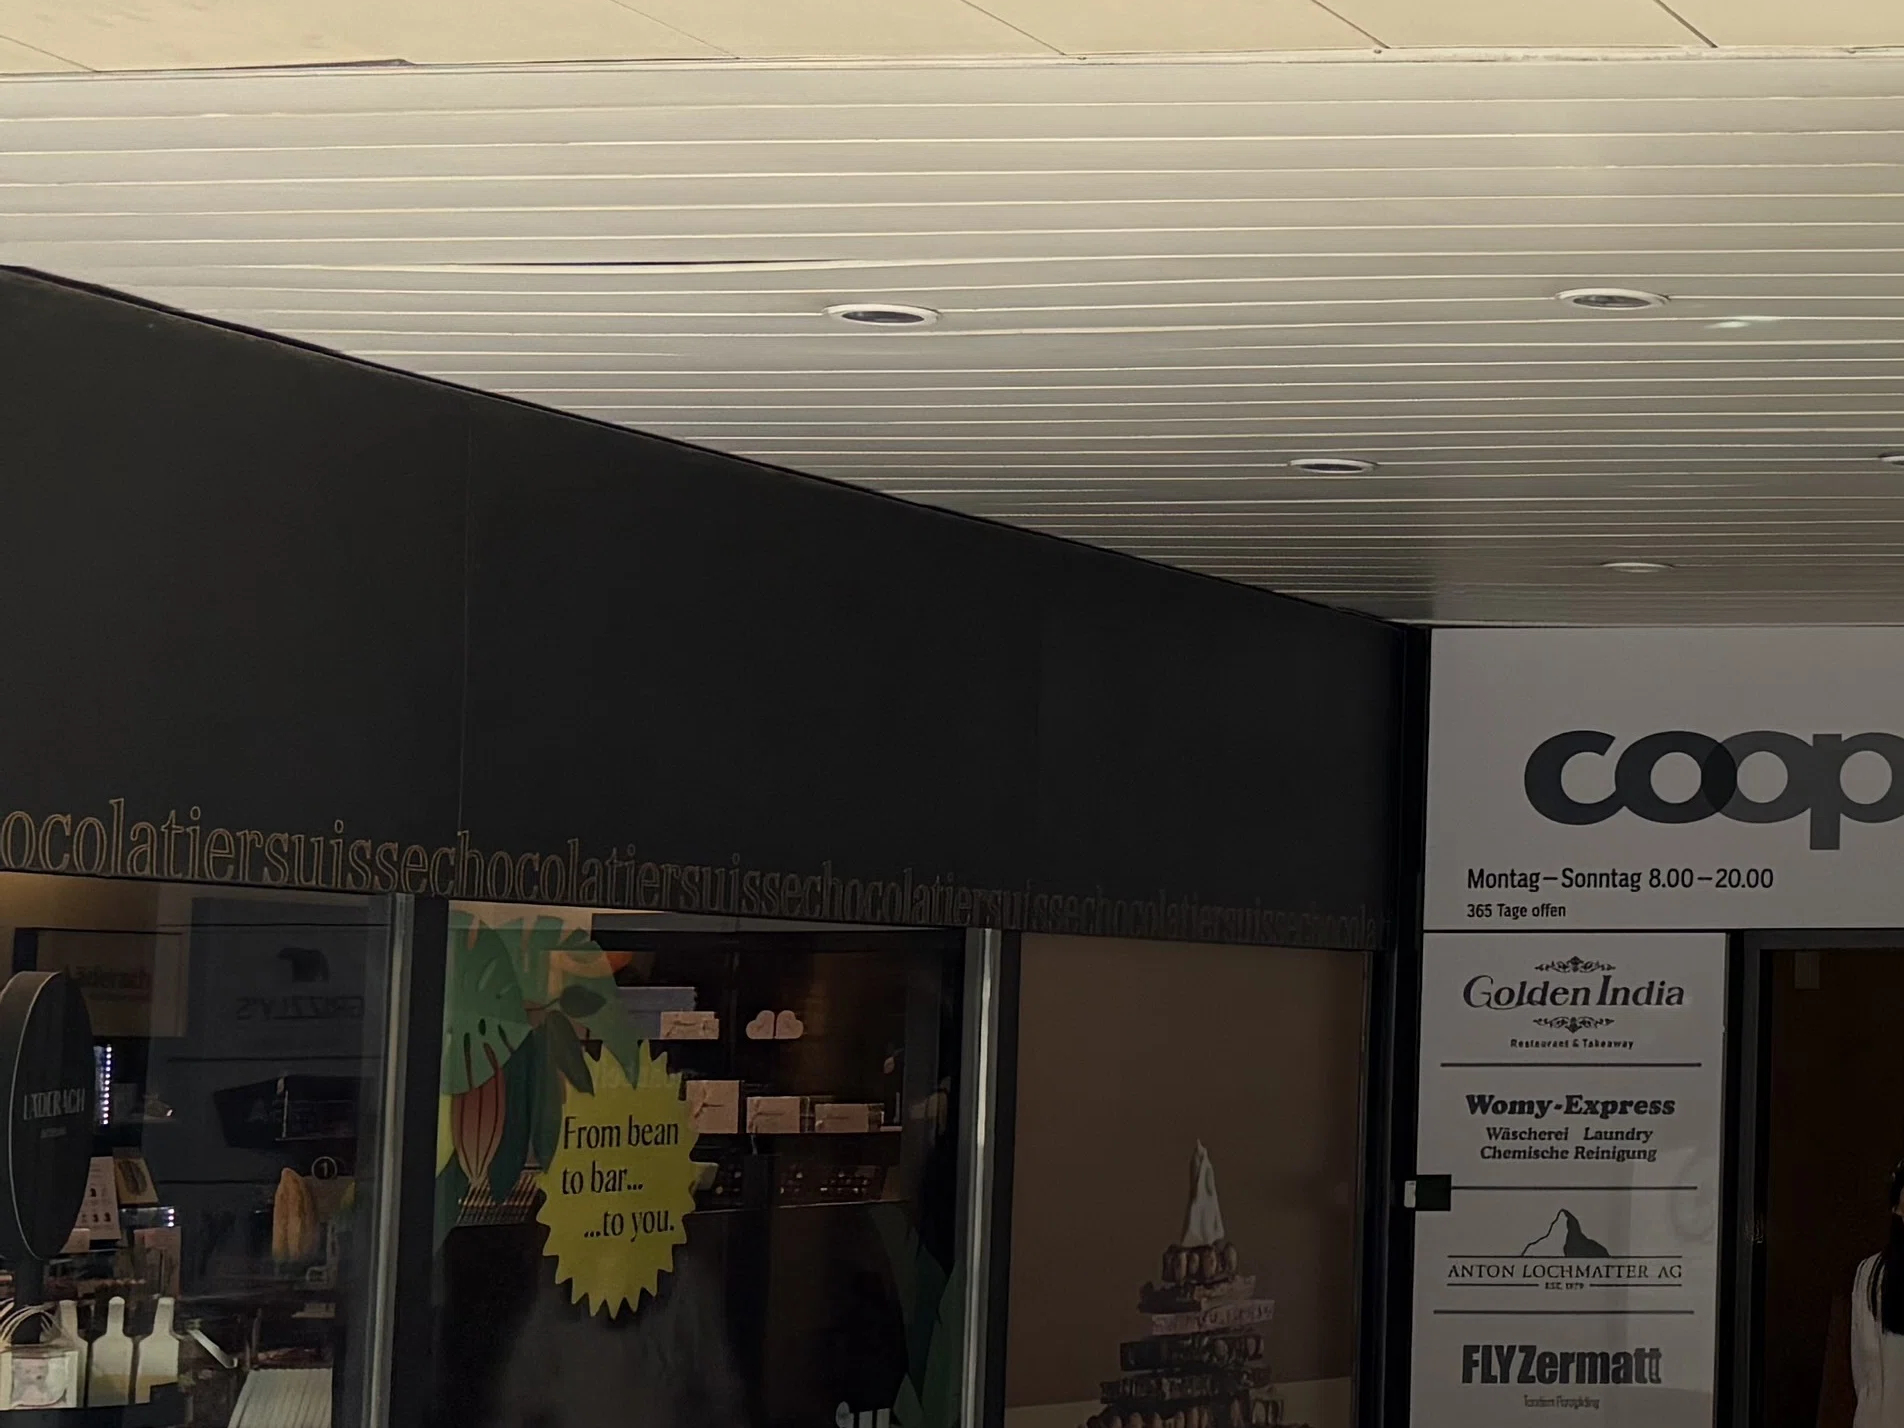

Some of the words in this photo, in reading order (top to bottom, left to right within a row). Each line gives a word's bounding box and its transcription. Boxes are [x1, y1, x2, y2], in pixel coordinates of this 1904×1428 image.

[1467, 903, 1493, 918] 365
[1497, 903, 1528, 921] Tage
[1532, 902, 1566, 918] offen
[1463, 975, 1591, 1011] Golden
[1597, 974, 1684, 1007] India
[1466, 1094, 1676, 1120] Womy-Express
[563, 1115, 621, 1150] From
[627, 1114, 680, 1148] bean
[1486, 1126, 1569, 1143] Wäscherei
[1583, 1126, 1654, 1145] Laundry
[1480, 1144, 1570, 1161] Chemische
[1573, 1144, 1658, 1163] Reinigung
[562, 1168, 584, 1195] to
[590, 1161, 643, 1193] bar...
[631, 1209, 675, 1243] you.
[1447, 1263, 1515, 1280] ANTON
[1522, 1263, 1649, 1280] LOCHMATTER
[1656, 1263, 1683, 1280] AG
